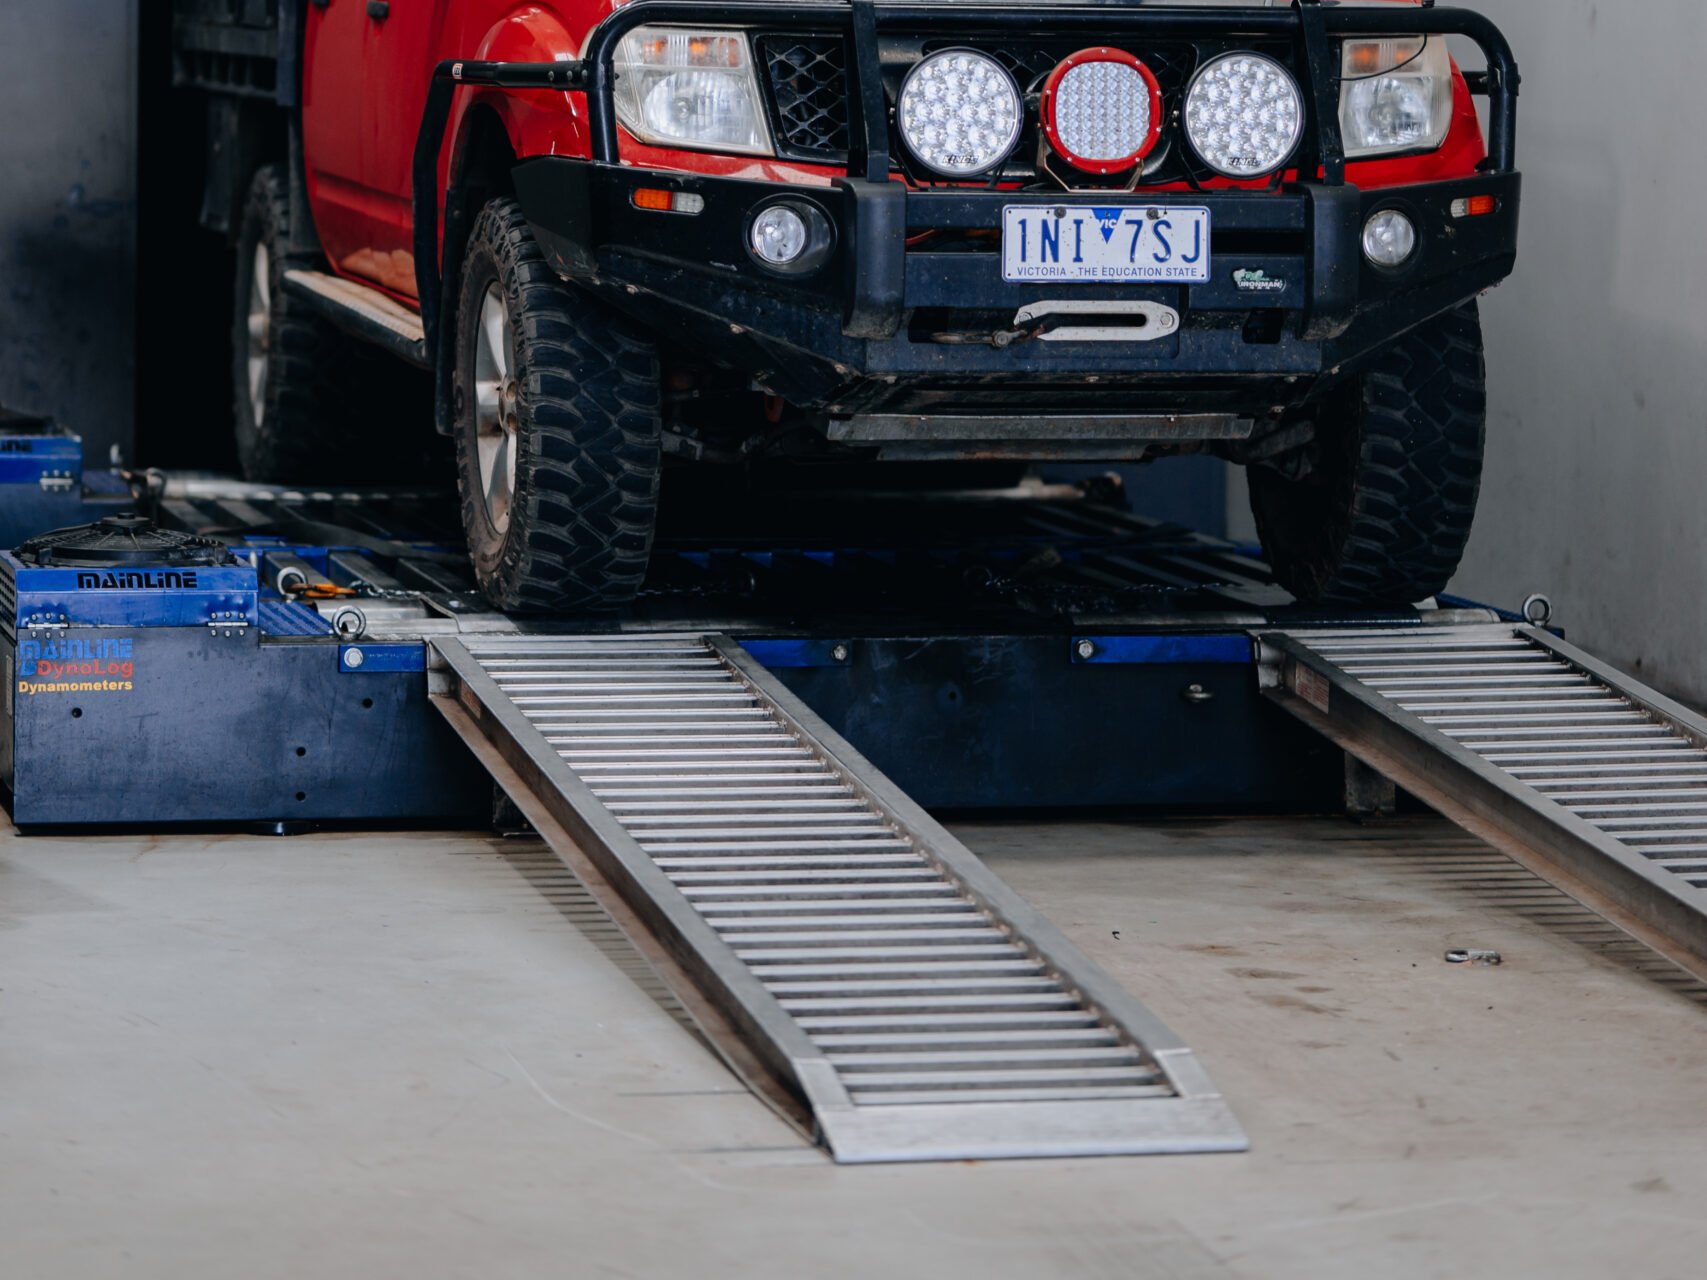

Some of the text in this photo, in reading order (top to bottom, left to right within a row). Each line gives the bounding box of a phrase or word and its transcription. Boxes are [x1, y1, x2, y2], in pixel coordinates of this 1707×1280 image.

[1018, 218, 1200, 263] 1NI 7SJ
[1017, 267, 1066, 276] VICTORIA
[1078, 267, 1097, 276] THE
[1102, 267, 1162, 277] EDUCATION
[1166, 267, 1197, 277] STATE
[37, 659, 133, 679] DynoLog
[19, 680, 133, 695] Dynamometers
